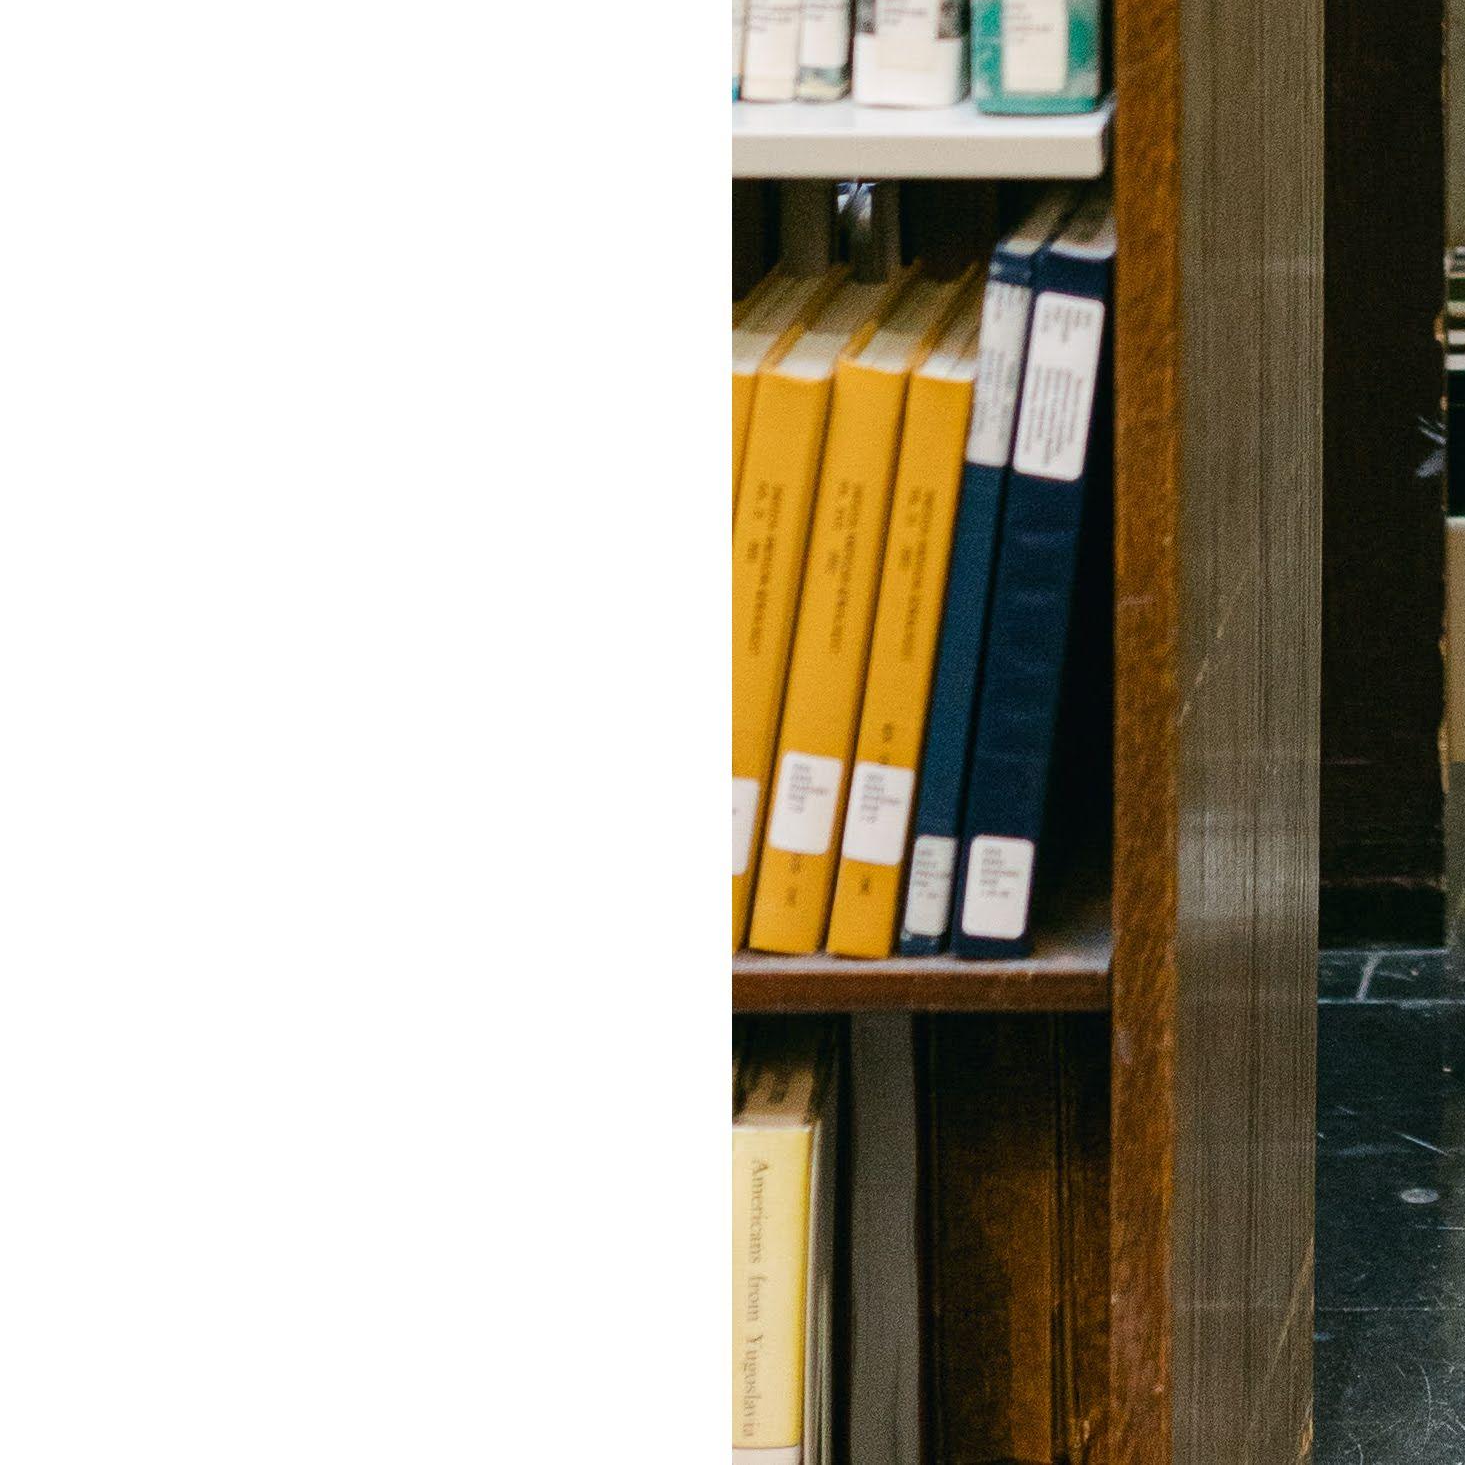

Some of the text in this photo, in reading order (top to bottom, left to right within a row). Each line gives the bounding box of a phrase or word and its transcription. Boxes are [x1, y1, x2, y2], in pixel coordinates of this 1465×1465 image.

[743, 1157, 769, 1438] Americans from Yugoslavia
